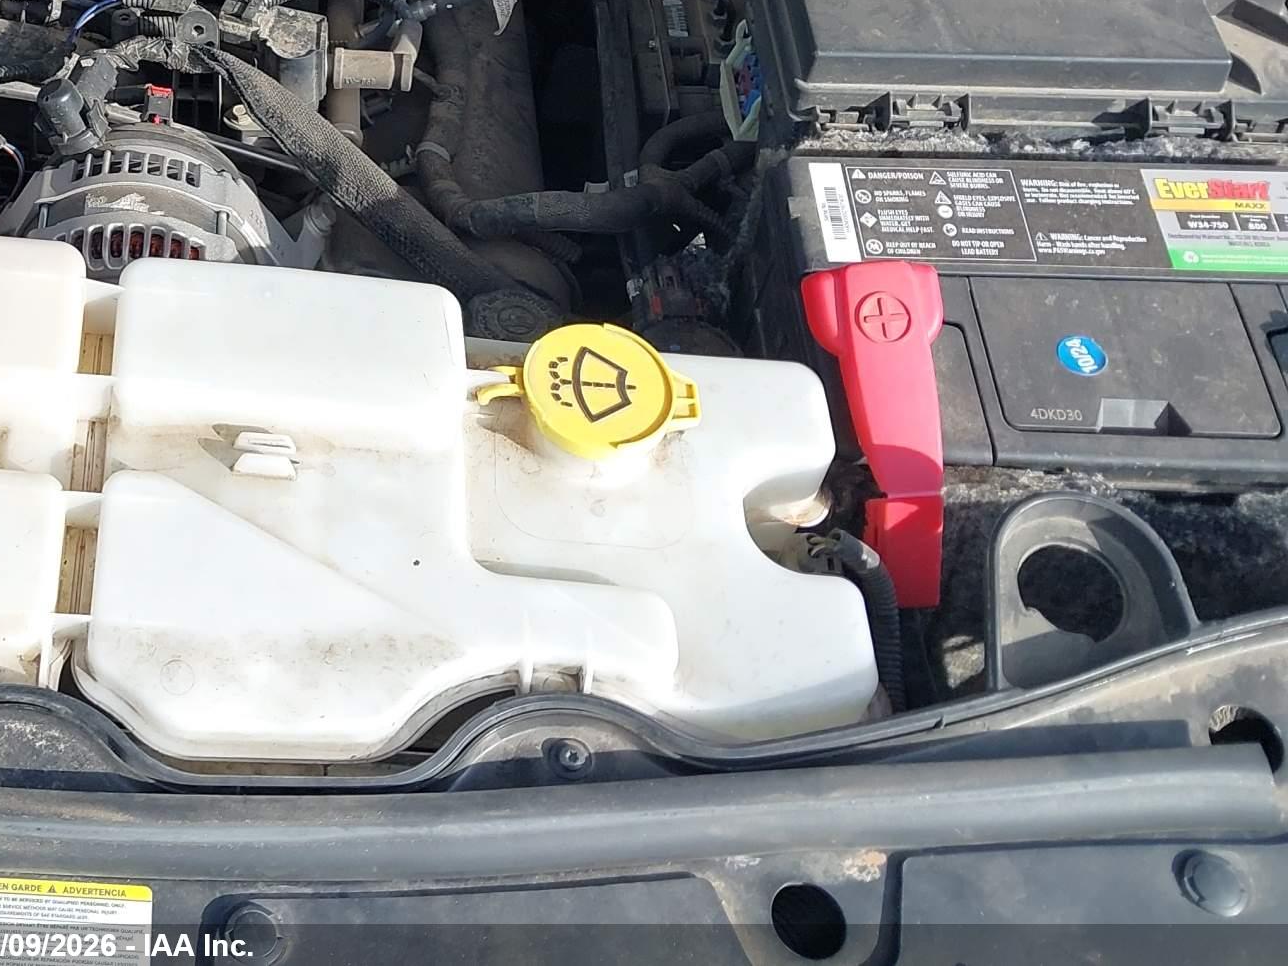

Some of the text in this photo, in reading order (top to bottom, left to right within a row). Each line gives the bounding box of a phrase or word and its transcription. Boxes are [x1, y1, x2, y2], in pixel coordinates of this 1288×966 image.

[867, 171, 924, 180] DANGER/POISON
[1153, 178, 1271, 201] EverStart
[1234, 202, 1267, 210] MAXX
[1065, 338, 1098, 374] 10/24
[1030, 408, 1083, 421] 4DKD30
[11, 883, 42, 892] GARDE
[63, 886, 127, 898] ADVERTENCIA
